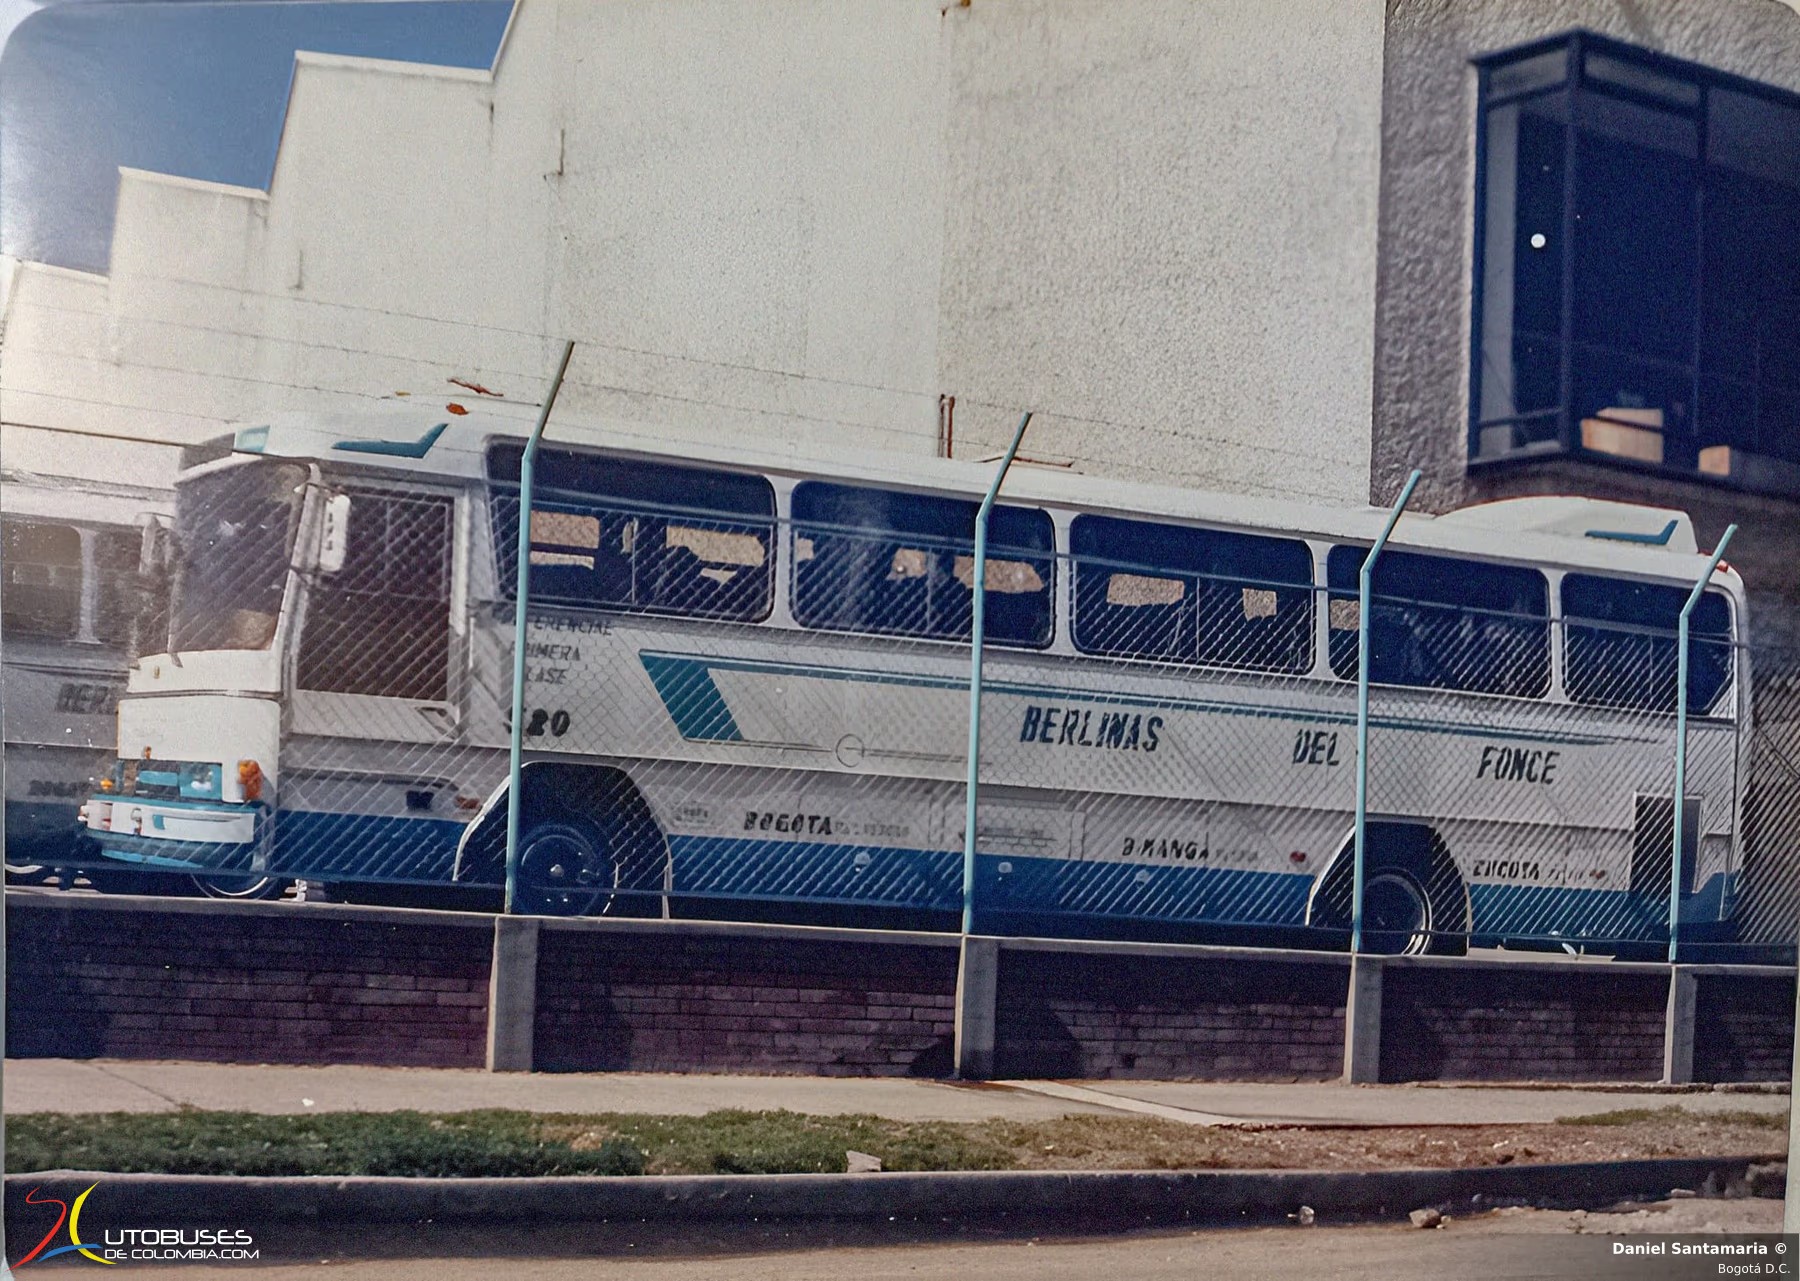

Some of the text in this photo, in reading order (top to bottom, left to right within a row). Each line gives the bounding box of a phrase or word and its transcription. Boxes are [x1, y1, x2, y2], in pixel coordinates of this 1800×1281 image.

[1019, 705, 1560, 784] BERLINAS DEL FONCE
[743, 811, 833, 835] BOGOTA
